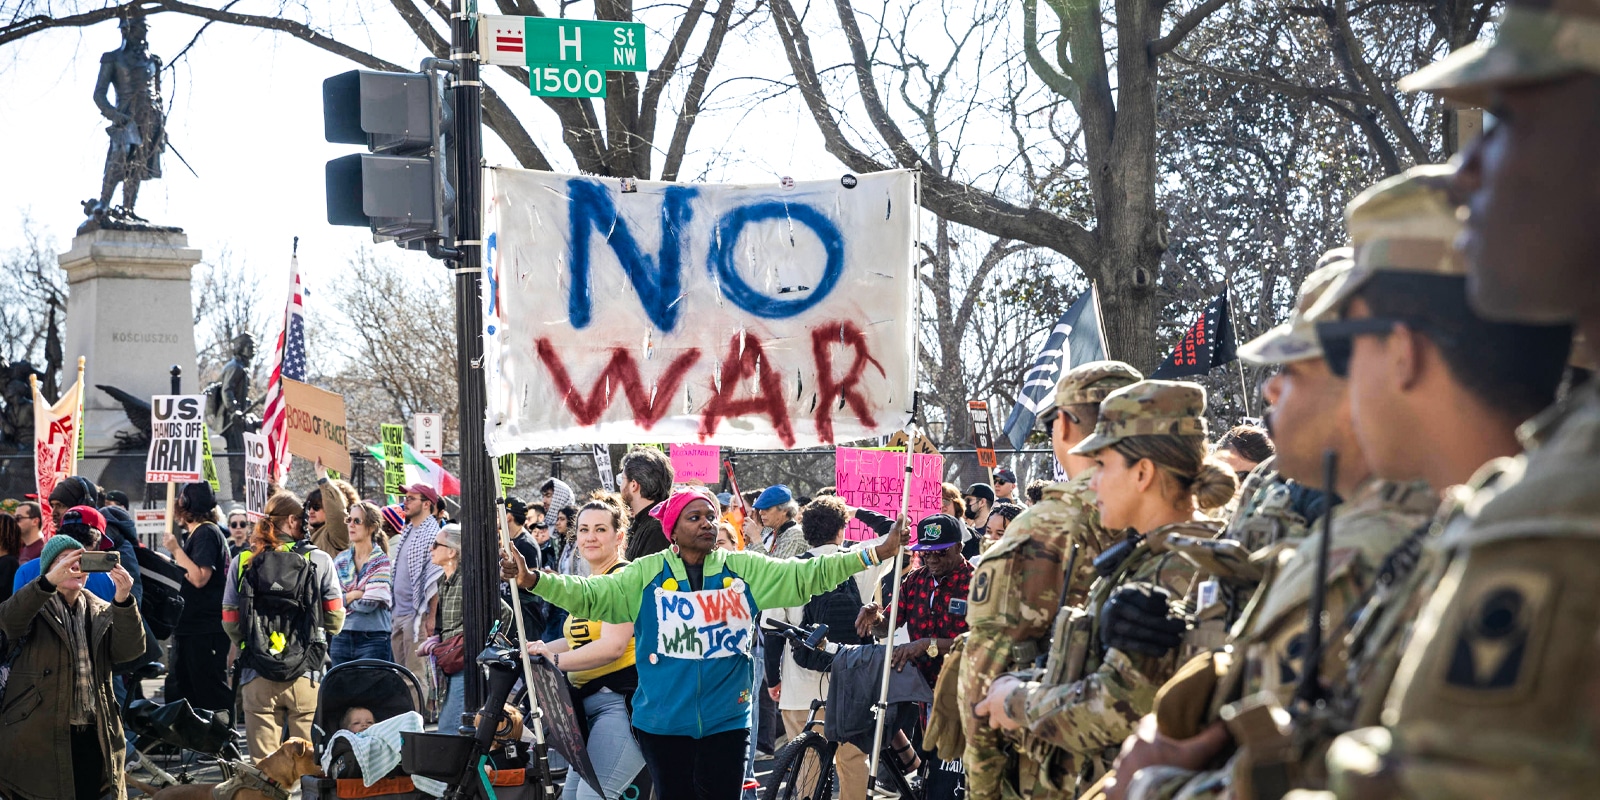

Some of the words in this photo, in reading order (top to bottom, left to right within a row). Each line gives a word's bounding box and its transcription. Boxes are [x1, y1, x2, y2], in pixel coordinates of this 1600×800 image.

[559, 26, 582, 61] H
[613, 27, 635, 46] St
[613, 47, 637, 66] NW
[533, 68, 603, 94] 1500
[566, 178, 845, 332] NO
[534, 320, 887, 448] WAR
[154, 397, 202, 421] U.S.
[153, 422, 182, 439] HANDS
[185, 422, 202, 438] OFF
[286, 403, 312, 433] BORED
[312, 415, 322, 435] OF
[323, 419, 348, 451] PEACE?
[150, 439, 198, 472] IRAN
[247, 440, 265, 459] NO
[843, 448, 886, 479] HEY
[247, 478, 267, 514] IRAN
[884, 494, 894, 508] 2
[921, 480, 942, 497] AND
[661, 594, 695, 621] NO
[695, 588, 749, 623] WAR
[662, 622, 703, 656] with
[698, 621, 748, 660] Iran
